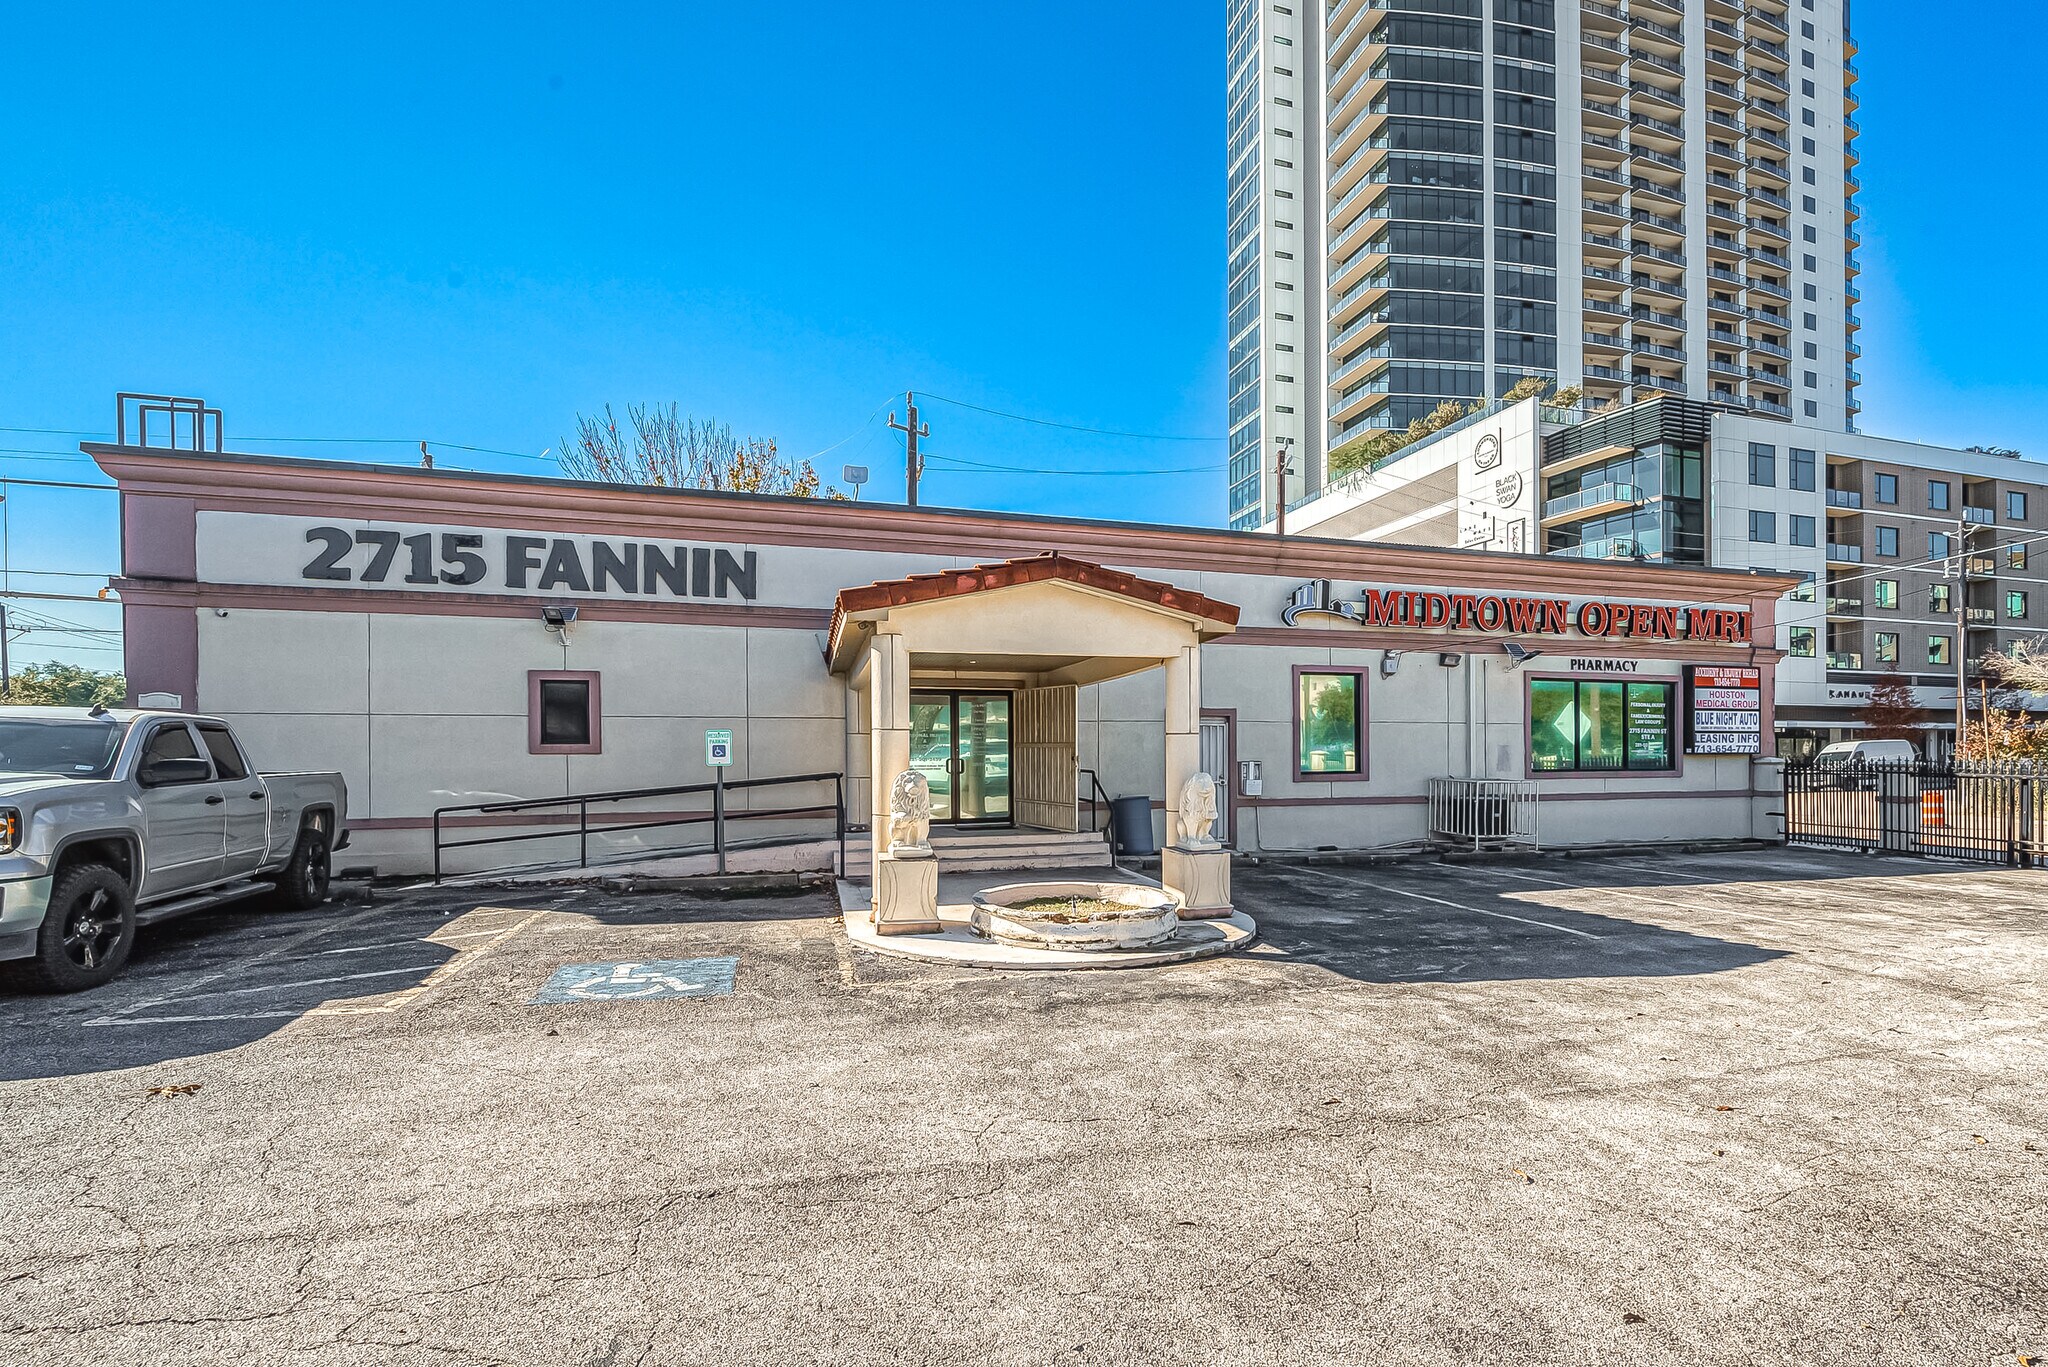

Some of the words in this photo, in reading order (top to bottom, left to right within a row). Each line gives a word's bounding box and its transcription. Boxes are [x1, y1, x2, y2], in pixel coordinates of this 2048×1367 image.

[1495, 473, 1517, 488] BLACK
[1495, 482, 1517, 496] SWAN
[1497, 492, 1515, 504] YOGA
[302, 526, 488, 586] 2715
[505, 535, 757, 600] FANNIN
[1362, 588, 1570, 635] MIDTOWN
[1579, 601, 1679, 639] OPEN
[1685, 607, 1754, 644] MRI
[1570, 658, 1639, 672] PHARMACY
[1709, 690, 1746, 699] HOUSTON
[1695, 699, 1730, 708] MEDICAL
[1731, 700, 1758, 709] GROUP
[1695, 712, 1714, 726] BLUE
[1715, 712, 1738, 726] NIGHT
[1740, 712, 1758, 726] AUTO
[1695, 733, 1735, 744] LEASING
[1737, 734, 1760, 744] INFO
[1695, 744, 1760, 754] 713-654-7770
